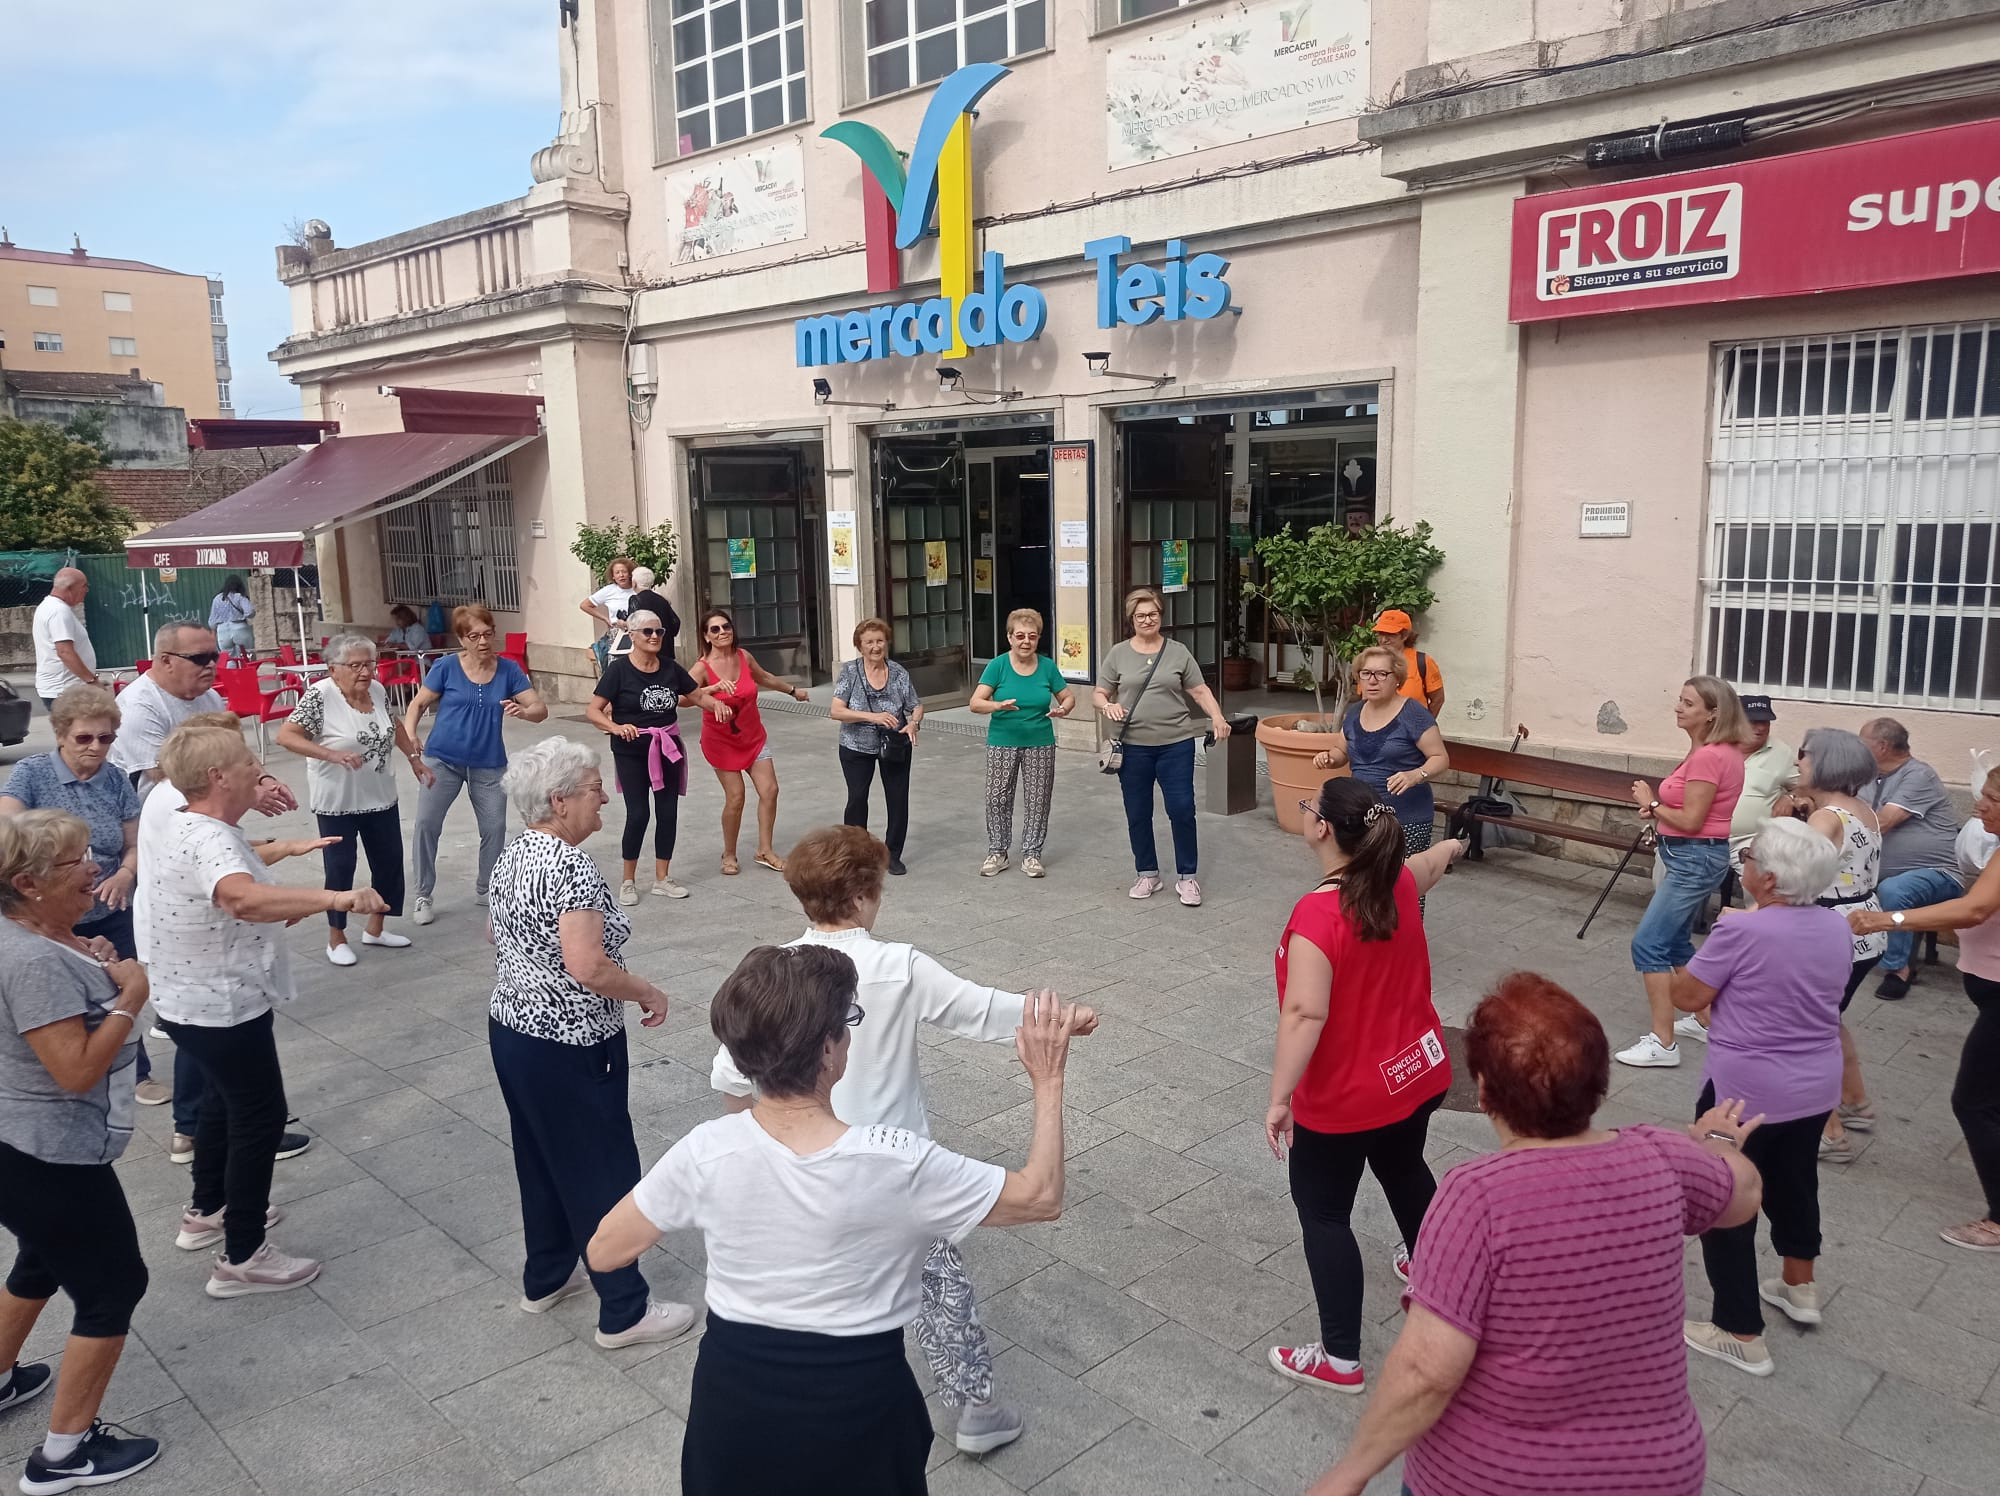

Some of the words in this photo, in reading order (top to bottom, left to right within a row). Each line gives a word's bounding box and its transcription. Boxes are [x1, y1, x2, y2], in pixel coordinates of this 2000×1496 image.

[1274, 39, 1317, 57] MERCACEVI
[1298, 49, 1325, 61] compra
[1327, 43, 1350, 54] fresco
[1311, 55, 1333, 66] COME
[1335, 49, 1356, 61] SANO
[1121, 110, 1183, 137] MERCADOS
[1187, 105, 1202, 121] DE
[1242, 78, 1314, 107] MERCADOS
[1317, 68, 1356, 89] VIVOS
[1545, 189, 1732, 273] FROIZ
[1574, 271, 1630, 287] Siempre
[1633, 271, 1641, 280] a
[1645, 268, 1661, 278] su
[1665, 259, 1723, 276] servicio
[796, 250, 1047, 368] mercado
[1084, 235, 1230, 330] Teis
[1054, 449, 1086, 460] OFERTAS
[1585, 506, 1626, 515] PROHIBIDO
[154, 553, 171, 566] CAFE
[252, 551, 269, 566] BAR
[1386, 1048, 1421, 1076] CONCELLO
[1395, 1072, 1407, 1084] DE
[1405, 1060, 1422, 1076] VIGO
